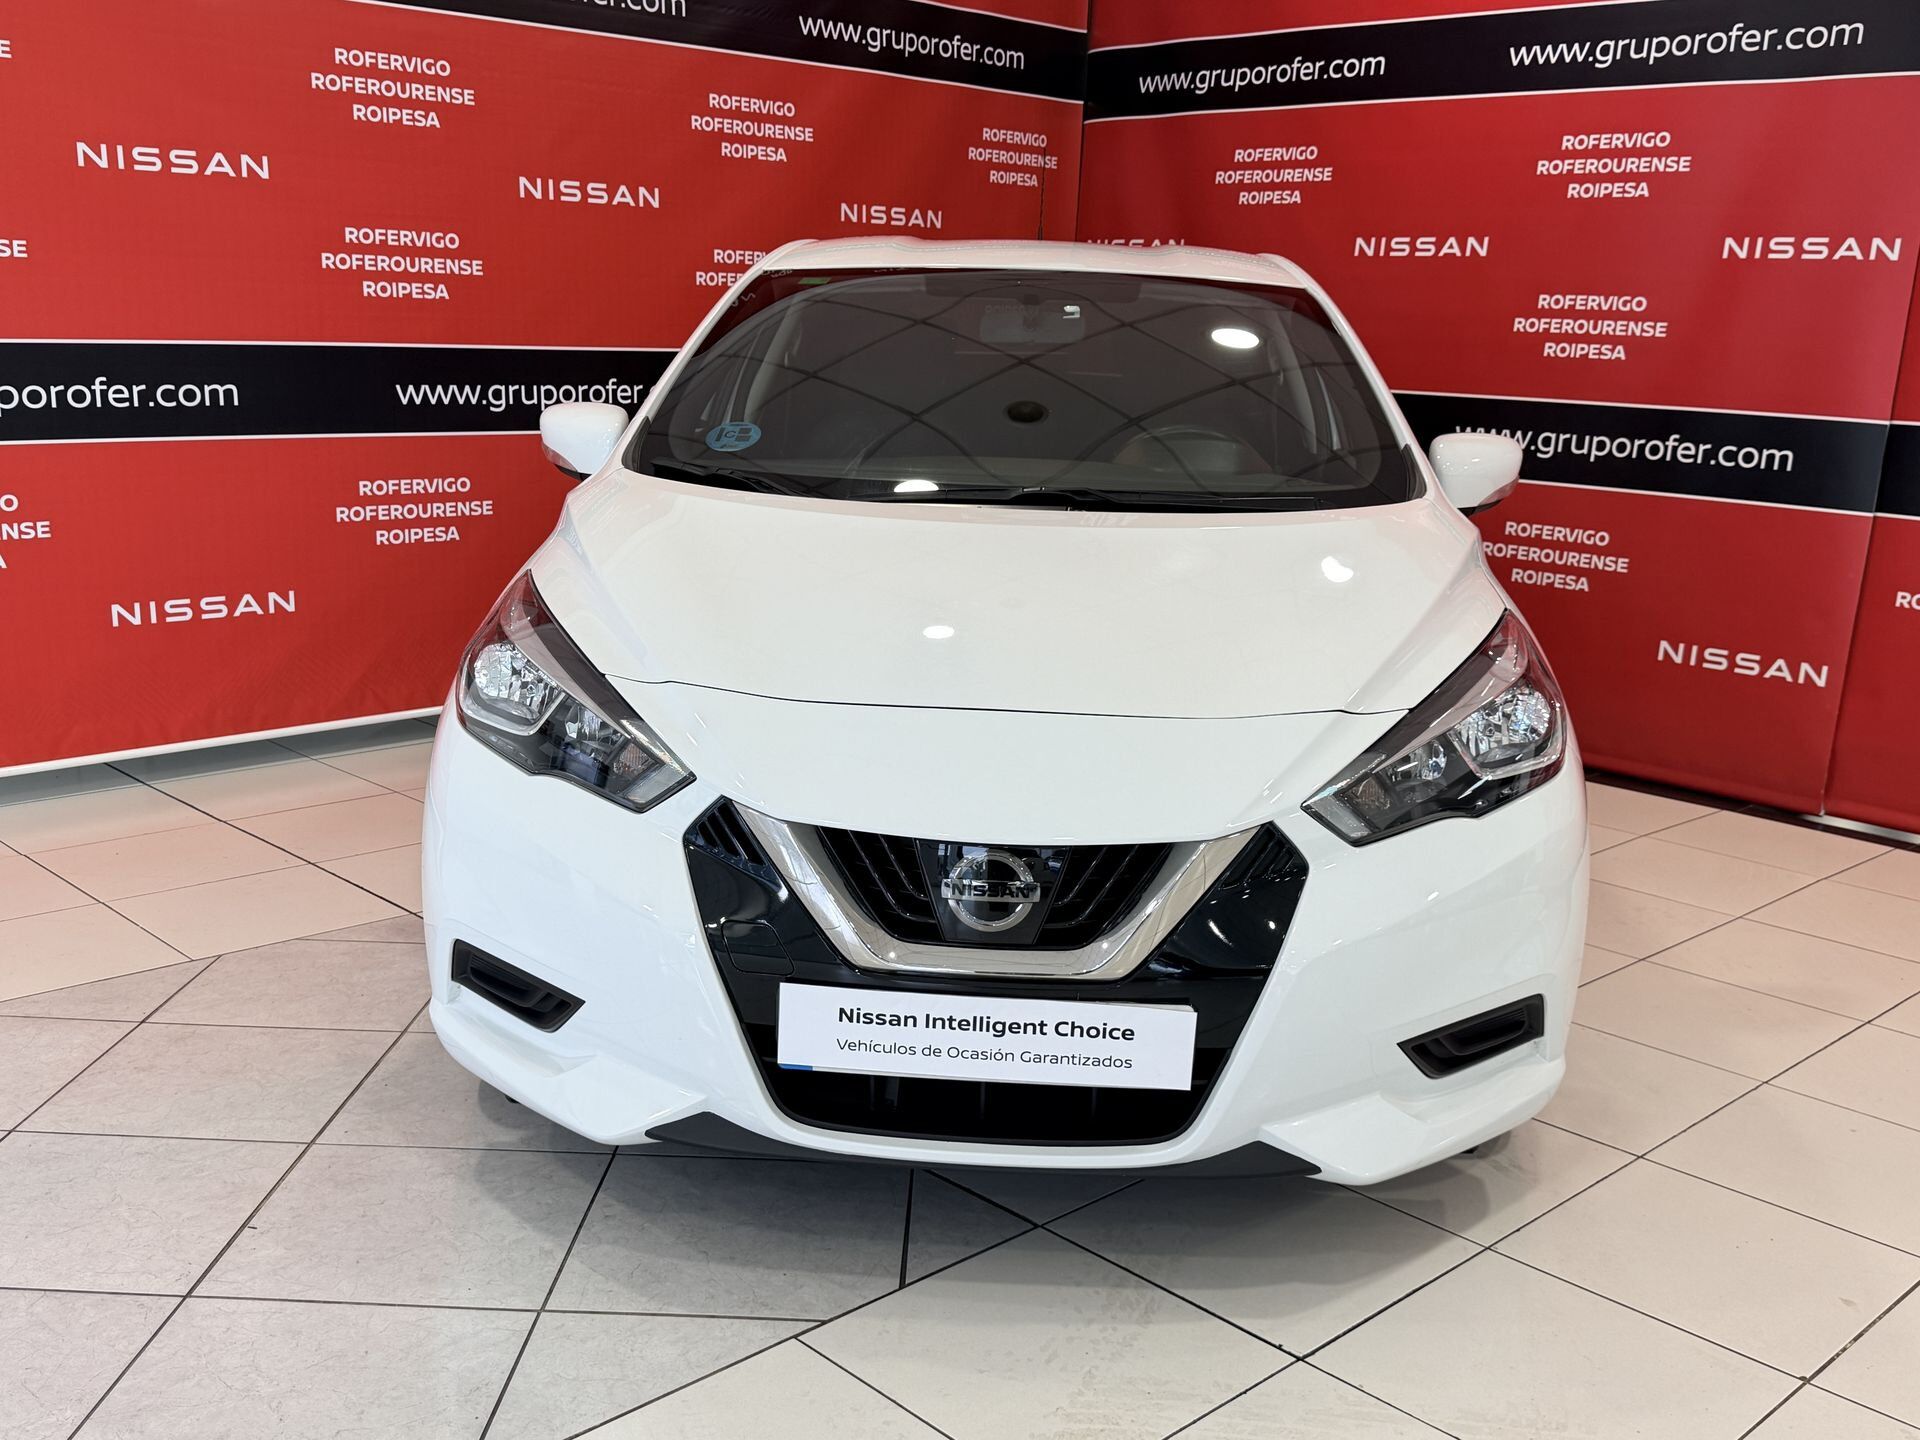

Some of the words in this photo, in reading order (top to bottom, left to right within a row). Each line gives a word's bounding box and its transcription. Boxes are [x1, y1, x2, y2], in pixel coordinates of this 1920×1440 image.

[799, 16, 1024, 69] www.gruporofer.com
[1510, 23, 1864, 68] www.gruporofer.com
[335, 48, 450, 76] ROFERVIGO
[1140, 56, 1385, 94] www.gruporofer.com
[311, 73, 475, 105] ROFEROURENSE
[353, 104, 440, 128] ROIPESA
[709, 93, 795, 117] ROFERVIGO
[691, 115, 813, 141] ROFEROURENSE
[981, 127, 1048, 148] ROFERVIGO
[722, 142, 787, 162] ROIPESA
[1562, 132, 1670, 150] ROFERVIGO
[76, 142, 269, 179] NISSAN
[968, 147, 1058, 169] ROFEROURENSE
[1234, 146, 1318, 162] ROFERVIGO
[1216, 168, 1332, 184] ROFEROURENSE
[1537, 157, 1691, 175] ROFEROURENSE
[990, 170, 1039, 188] ROIPESA
[1567, 182, 1649, 198] ROIPESA
[519, 176, 659, 208] NISSAN
[1239, 191, 1301, 204] ROIPESA
[841, 203, 941, 228] NISSAN
[345, 227, 459, 248] ROFERVIGO
[1354, 237, 1489, 256] NISSAN
[1723, 237, 1901, 261] NISSAN
[322, 253, 483, 275] ROFEROURENSE
[363, 281, 449, 299] ROIPESA
[1538, 295, 1647, 311] ROFERVIGO
[1514, 318, 1668, 337] ROFEROURENSE
[1544, 343, 1625, 360] ROIPESA
[359, 477, 470, 496] ROFERVIGO
[336, 501, 493, 522] ROFEROURENSE
[376, 527, 459, 545] ROIPESA
[1505, 521, 1610, 546] ROFERVIGO
[1483, 541, 1629, 572] ROFEROURENSE
[1511, 568, 1589, 591] ROIPESA
[111, 591, 295, 627] NISSAN
[1658, 640, 1828, 687] NISSAN
[951, 882, 1031, 899] NISSAN
[839, 1008, 917, 1027] Nissan
[926, 1014, 1047, 1037] Intelligent
[1055, 1021, 1134, 1040] Choice
[837, 1039, 916, 1055] Vehículos
[922, 1045, 941, 1057] de
[947, 1047, 1014, 1061] Ocasión
[1020, 1051, 1132, 1068] Garantizados
